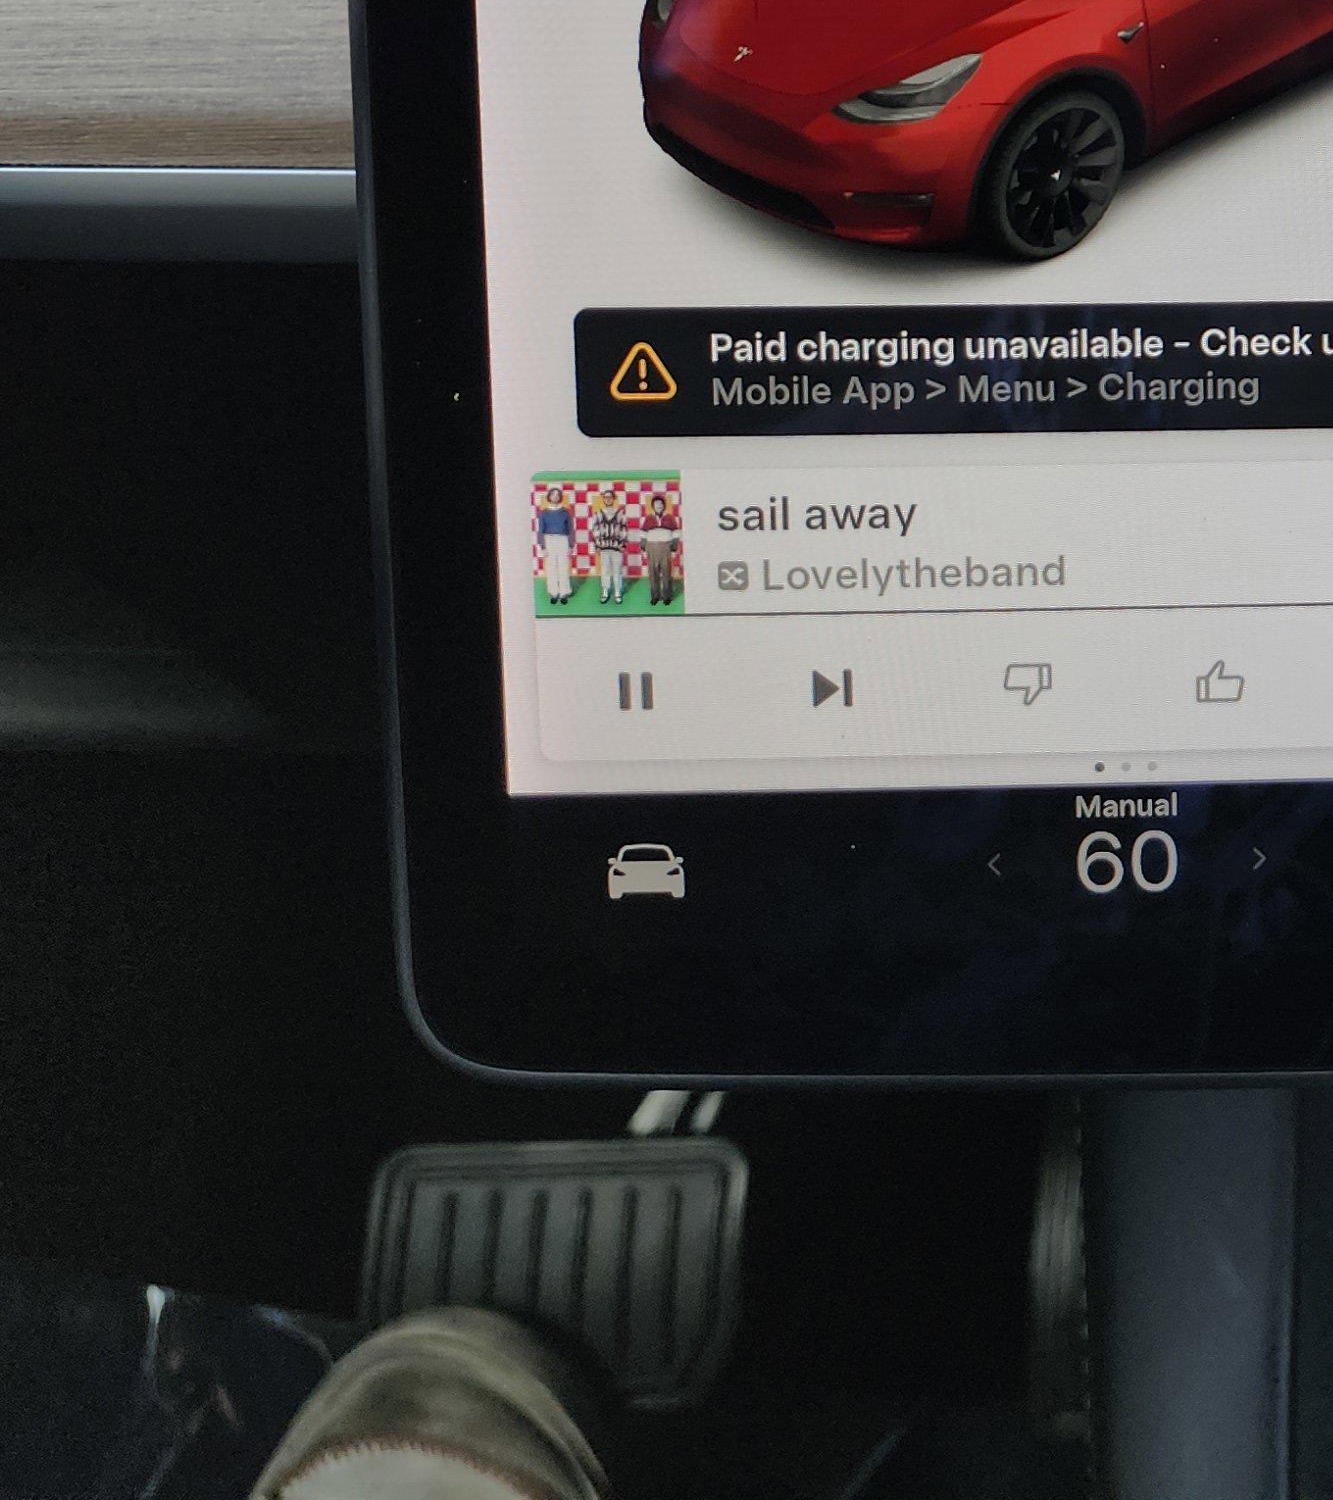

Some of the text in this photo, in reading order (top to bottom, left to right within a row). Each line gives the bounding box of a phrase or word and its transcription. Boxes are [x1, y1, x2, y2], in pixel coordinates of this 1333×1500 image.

[710, 331, 787, 363] Paid
[797, 330, 955, 367] charging
[965, 327, 1164, 360] unavailable
[1200, 326, 1312, 357] Check
[712, 375, 832, 406] Mobile
[842, 376, 915, 411] App
[959, 374, 1055, 403] Menu
[1099, 370, 1259, 407] Charging
[718, 496, 917, 537] sail away
[763, 554, 1065, 597] Lovelytheband
[1075, 791, 1178, 819] Manual
[1077, 829, 1178, 894] 60
